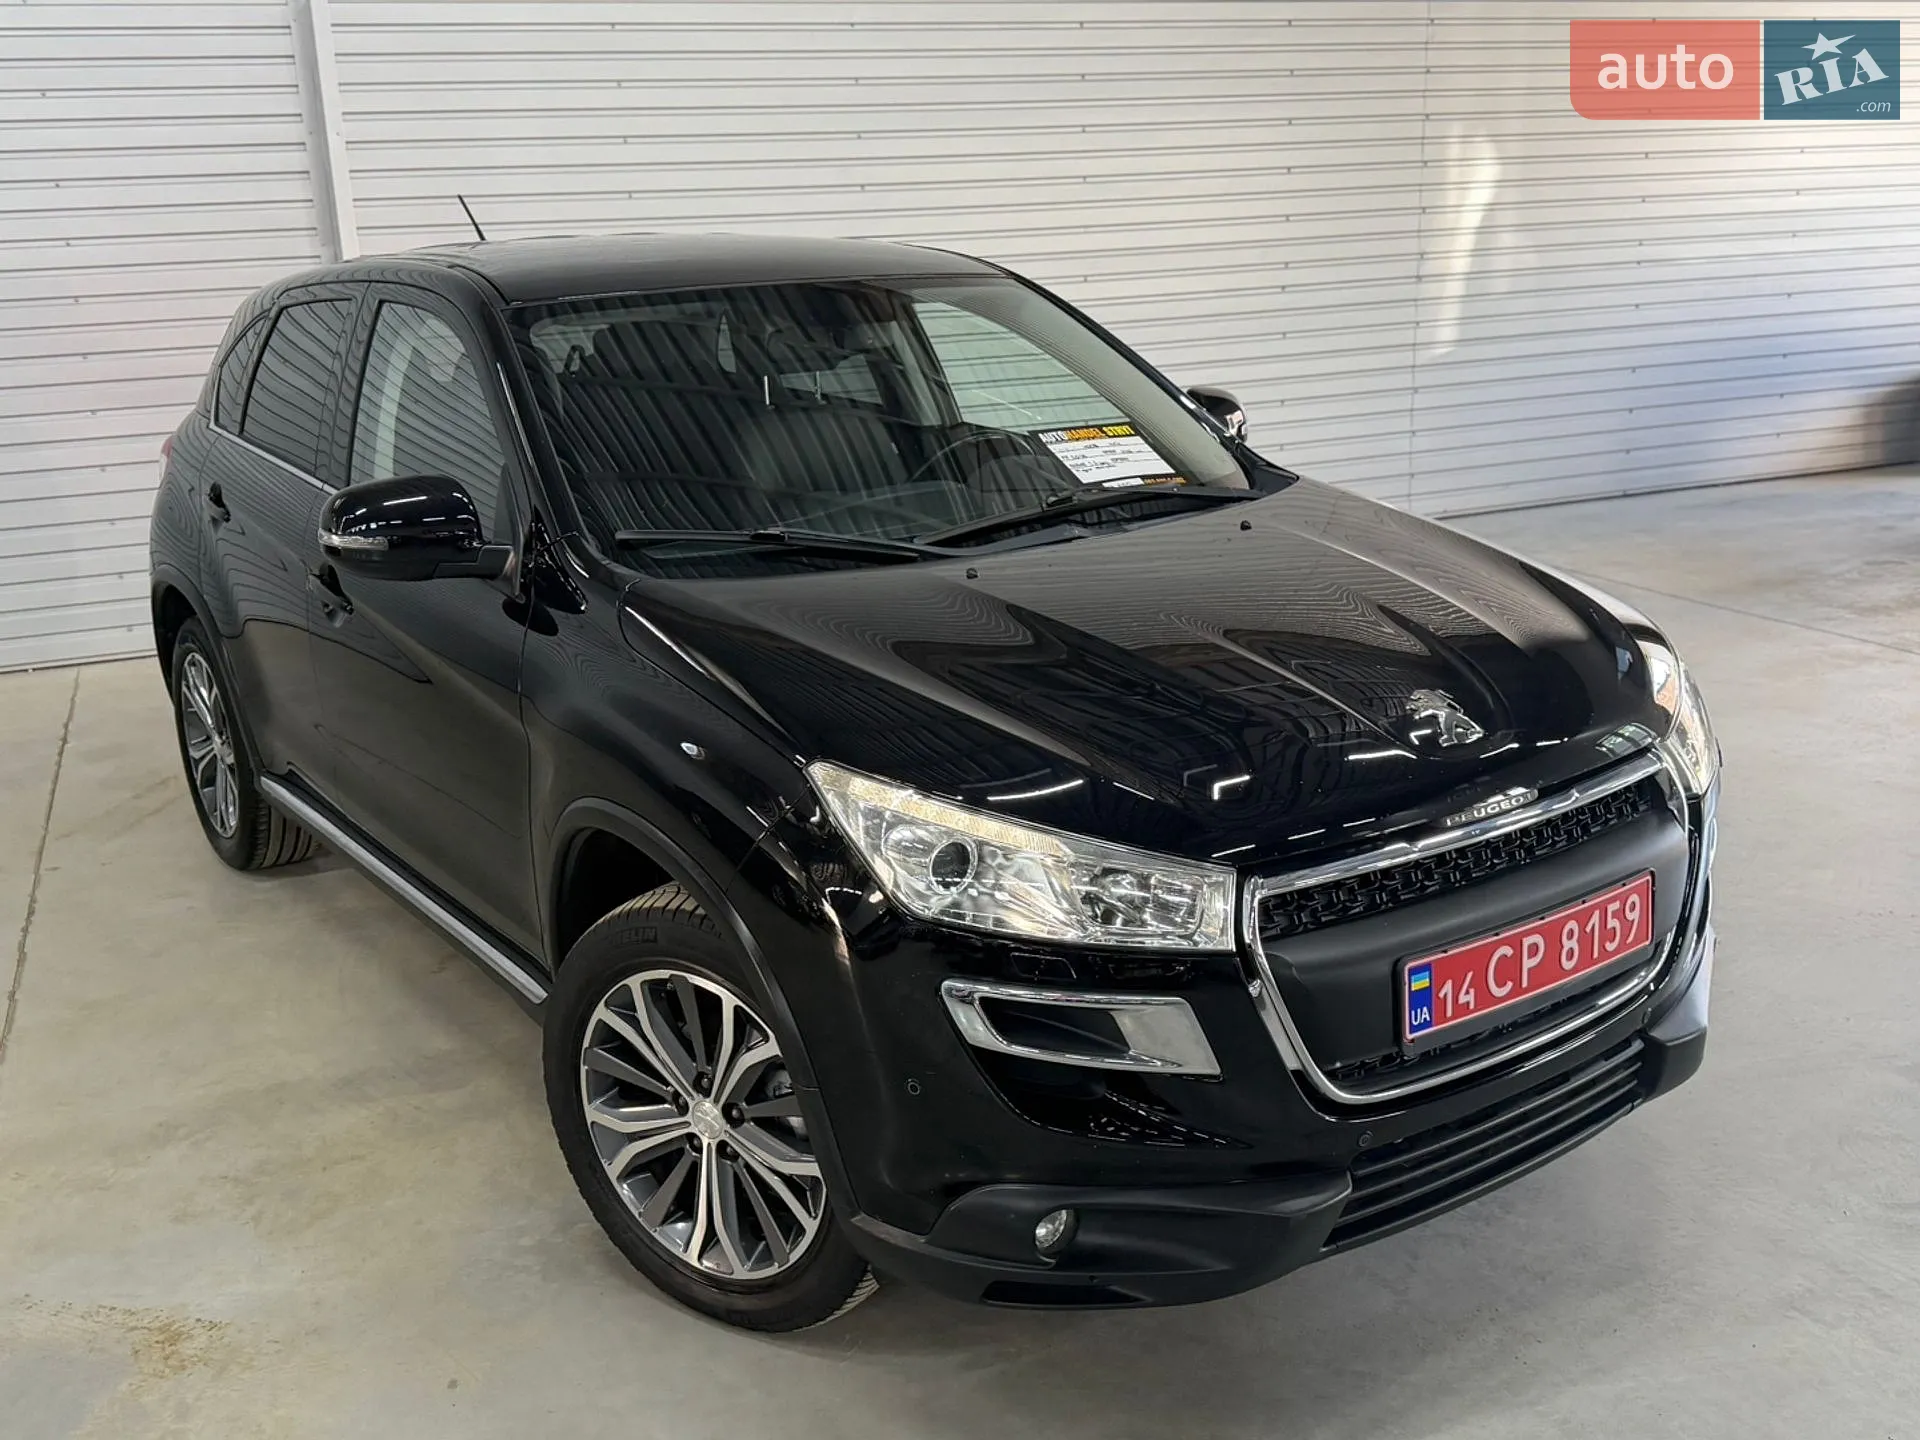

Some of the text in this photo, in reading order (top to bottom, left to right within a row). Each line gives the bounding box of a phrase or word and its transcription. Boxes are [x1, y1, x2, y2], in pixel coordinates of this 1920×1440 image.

[1438, 893, 1640, 1018] 14 CP 8159
[1411, 1007, 1430, 1025] UA
